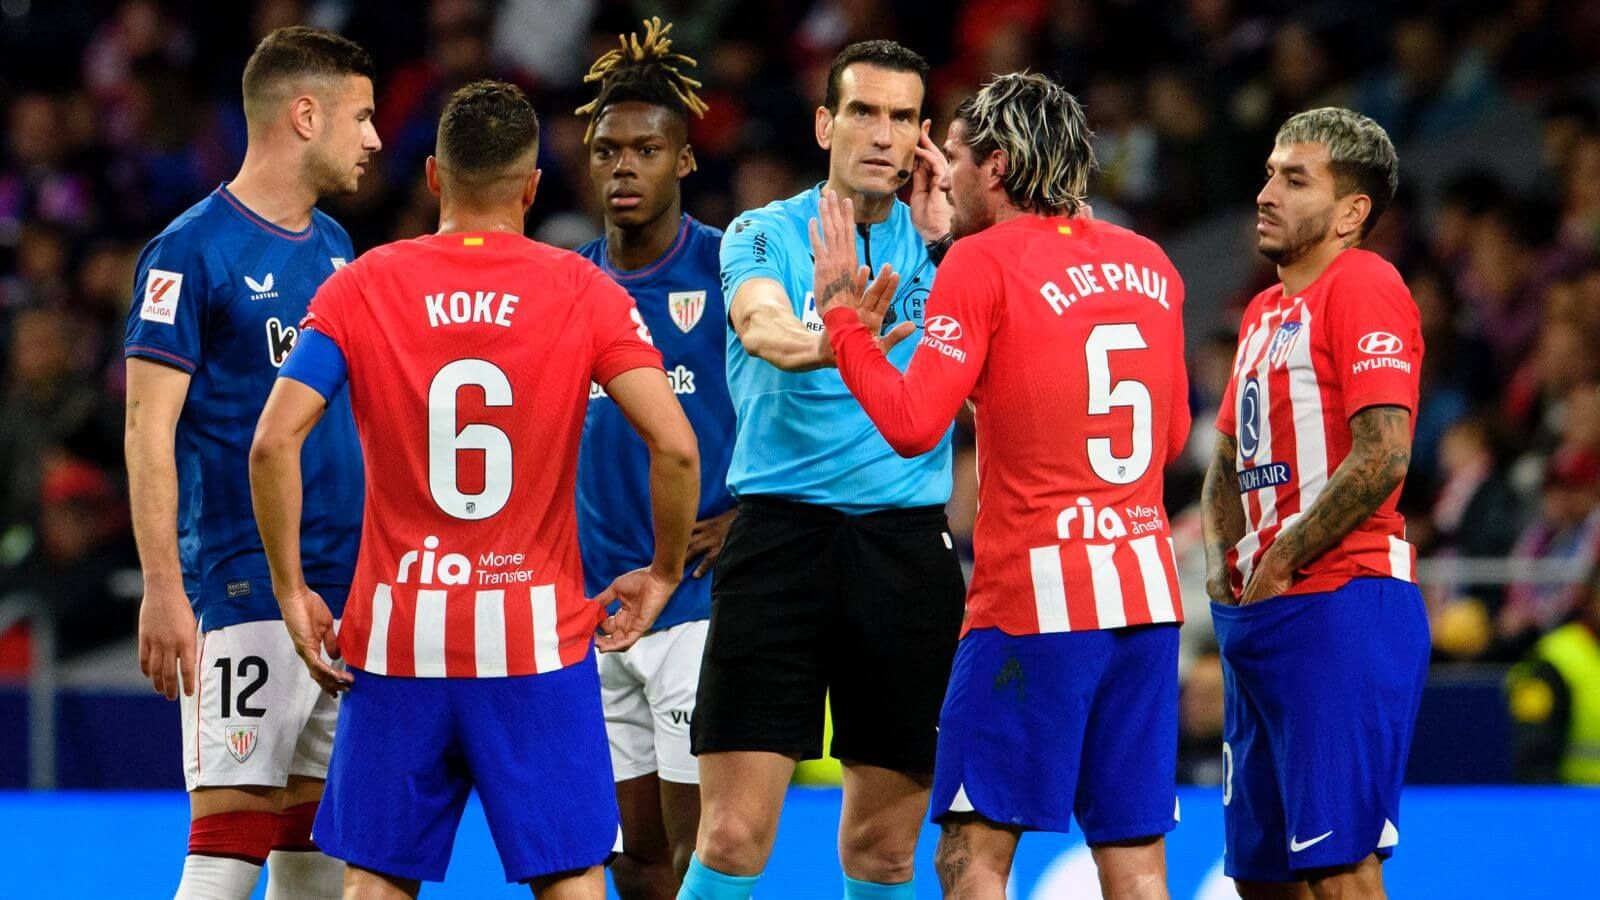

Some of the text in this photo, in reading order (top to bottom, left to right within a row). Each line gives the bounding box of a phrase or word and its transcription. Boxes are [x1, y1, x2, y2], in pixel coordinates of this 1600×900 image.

[424, 291, 519, 328] KOKE
[1039, 262, 1170, 316] R. DE PAUL
[806, 321, 825, 332] REF
[1352, 357, 1411, 375] HYUNDAI
[1085, 322, 1153, 485] 5
[427, 358, 514, 521] 6
[1261, 464, 1288, 484] AIR
[1056, 496, 1128, 540] ria
[396, 535, 472, 586] ria
[478, 551, 526, 567] Mone
[213, 655, 269, 718] 12
